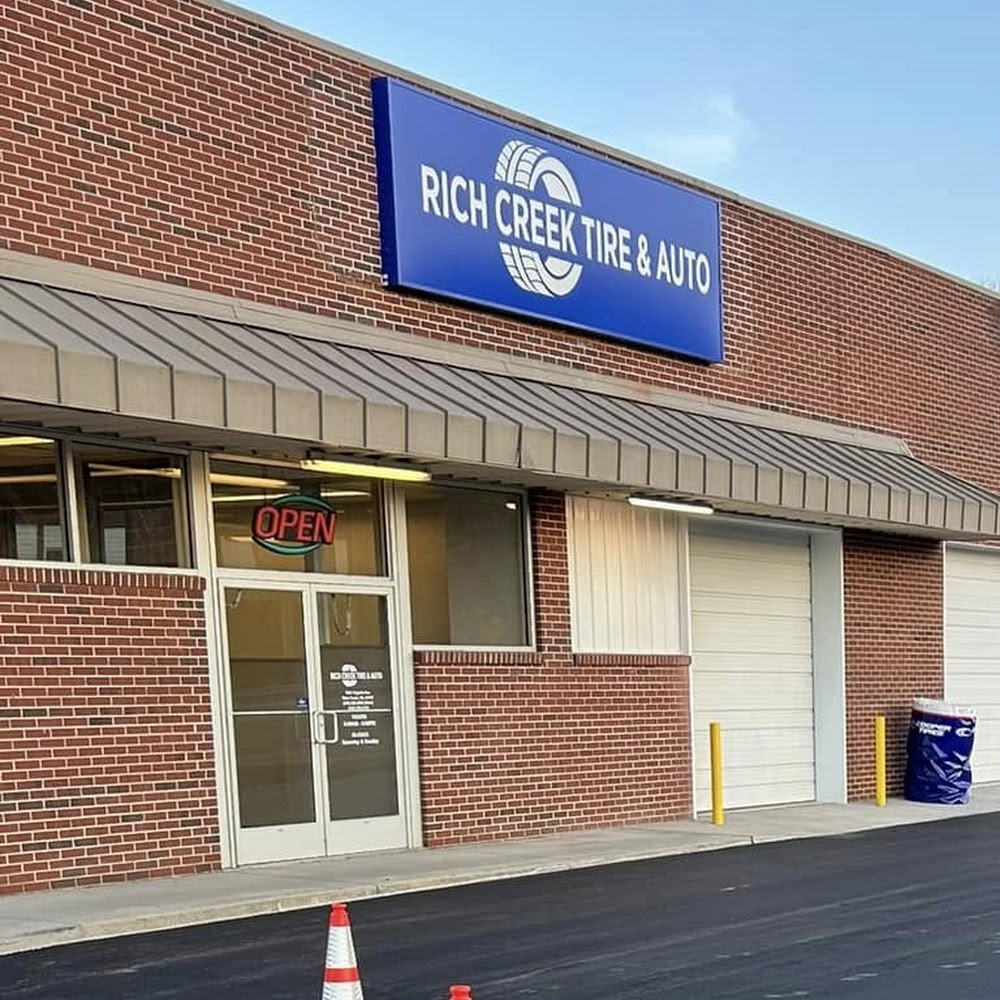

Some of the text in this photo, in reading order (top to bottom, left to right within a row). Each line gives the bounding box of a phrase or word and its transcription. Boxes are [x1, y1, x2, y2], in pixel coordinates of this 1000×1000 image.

[420, 164, 710, 294] RICH CREEK TIRE & AUTO
[255, 506, 336, 543] OPEN
